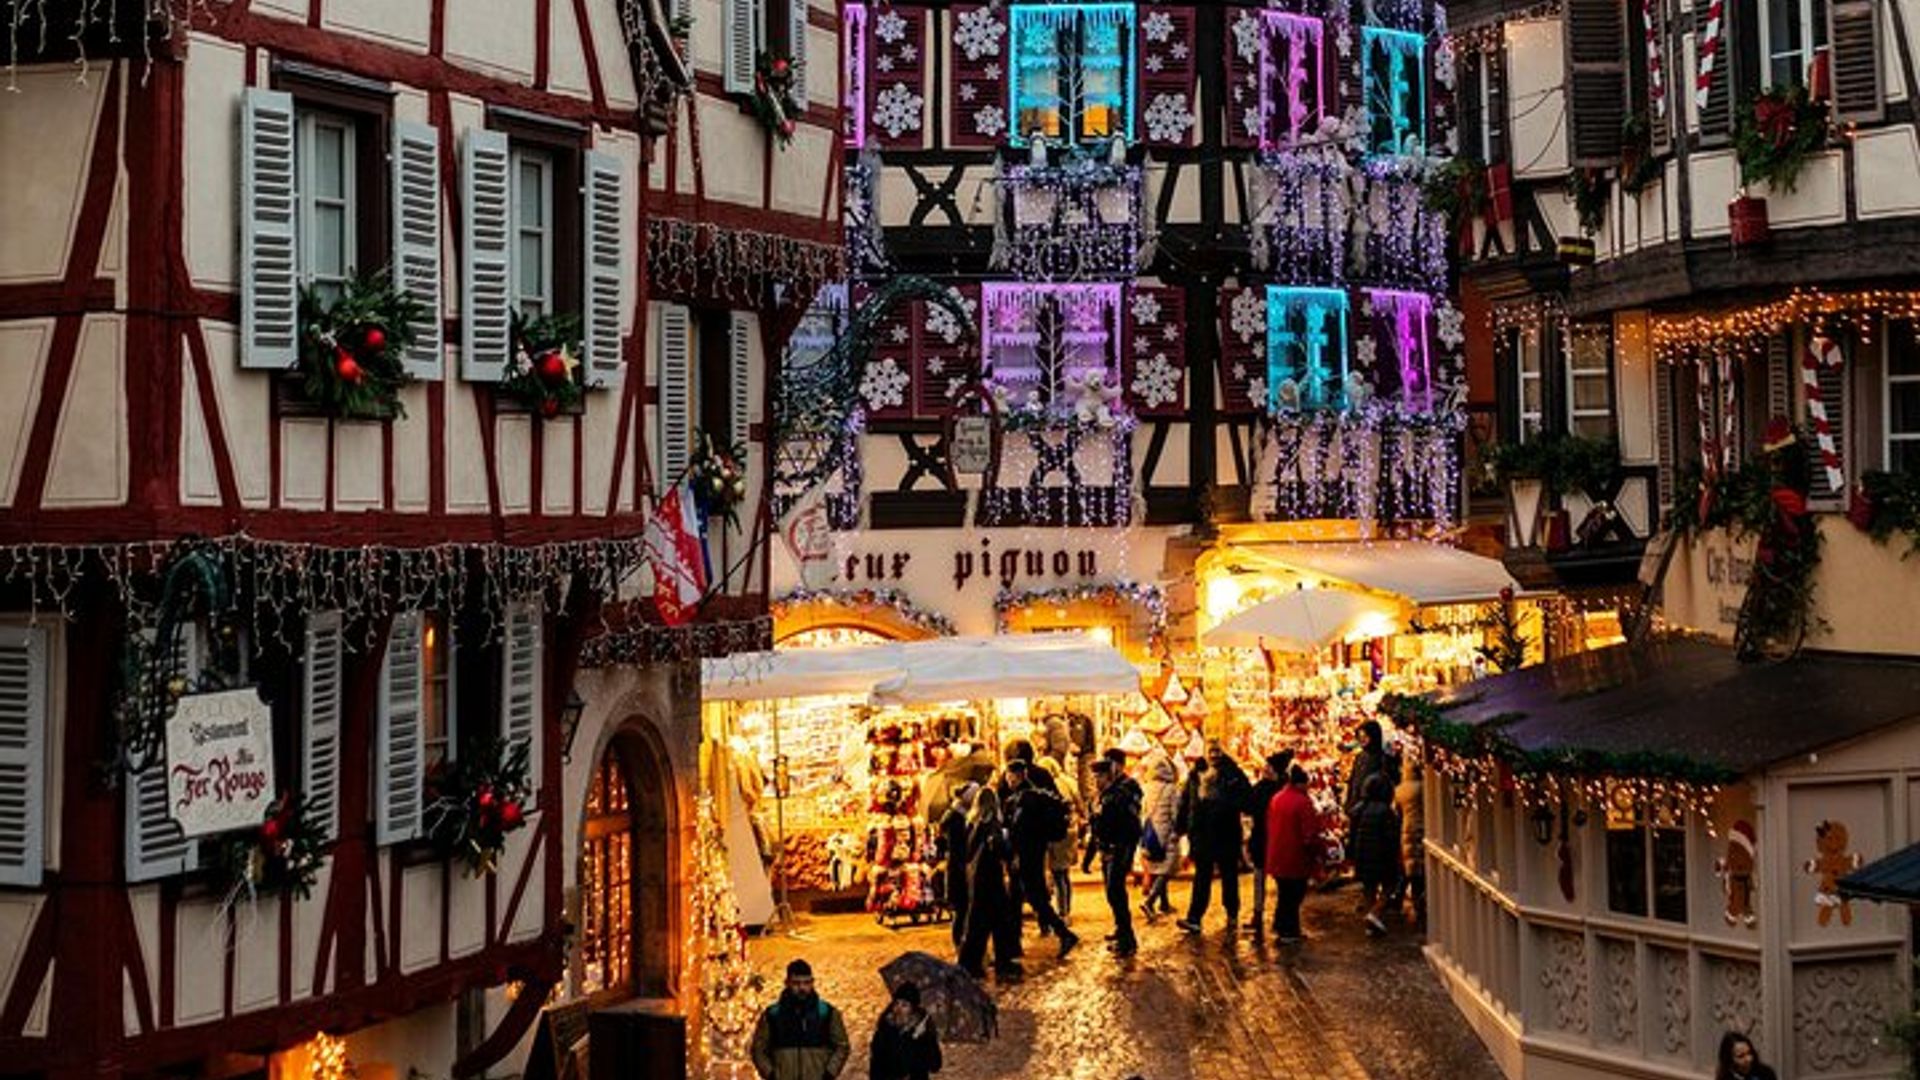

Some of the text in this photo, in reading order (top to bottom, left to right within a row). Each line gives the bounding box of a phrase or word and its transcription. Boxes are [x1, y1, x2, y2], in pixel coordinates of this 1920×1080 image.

[953, 537, 1097, 591] pignon
[172, 754, 267, 808] Fer Rouge
